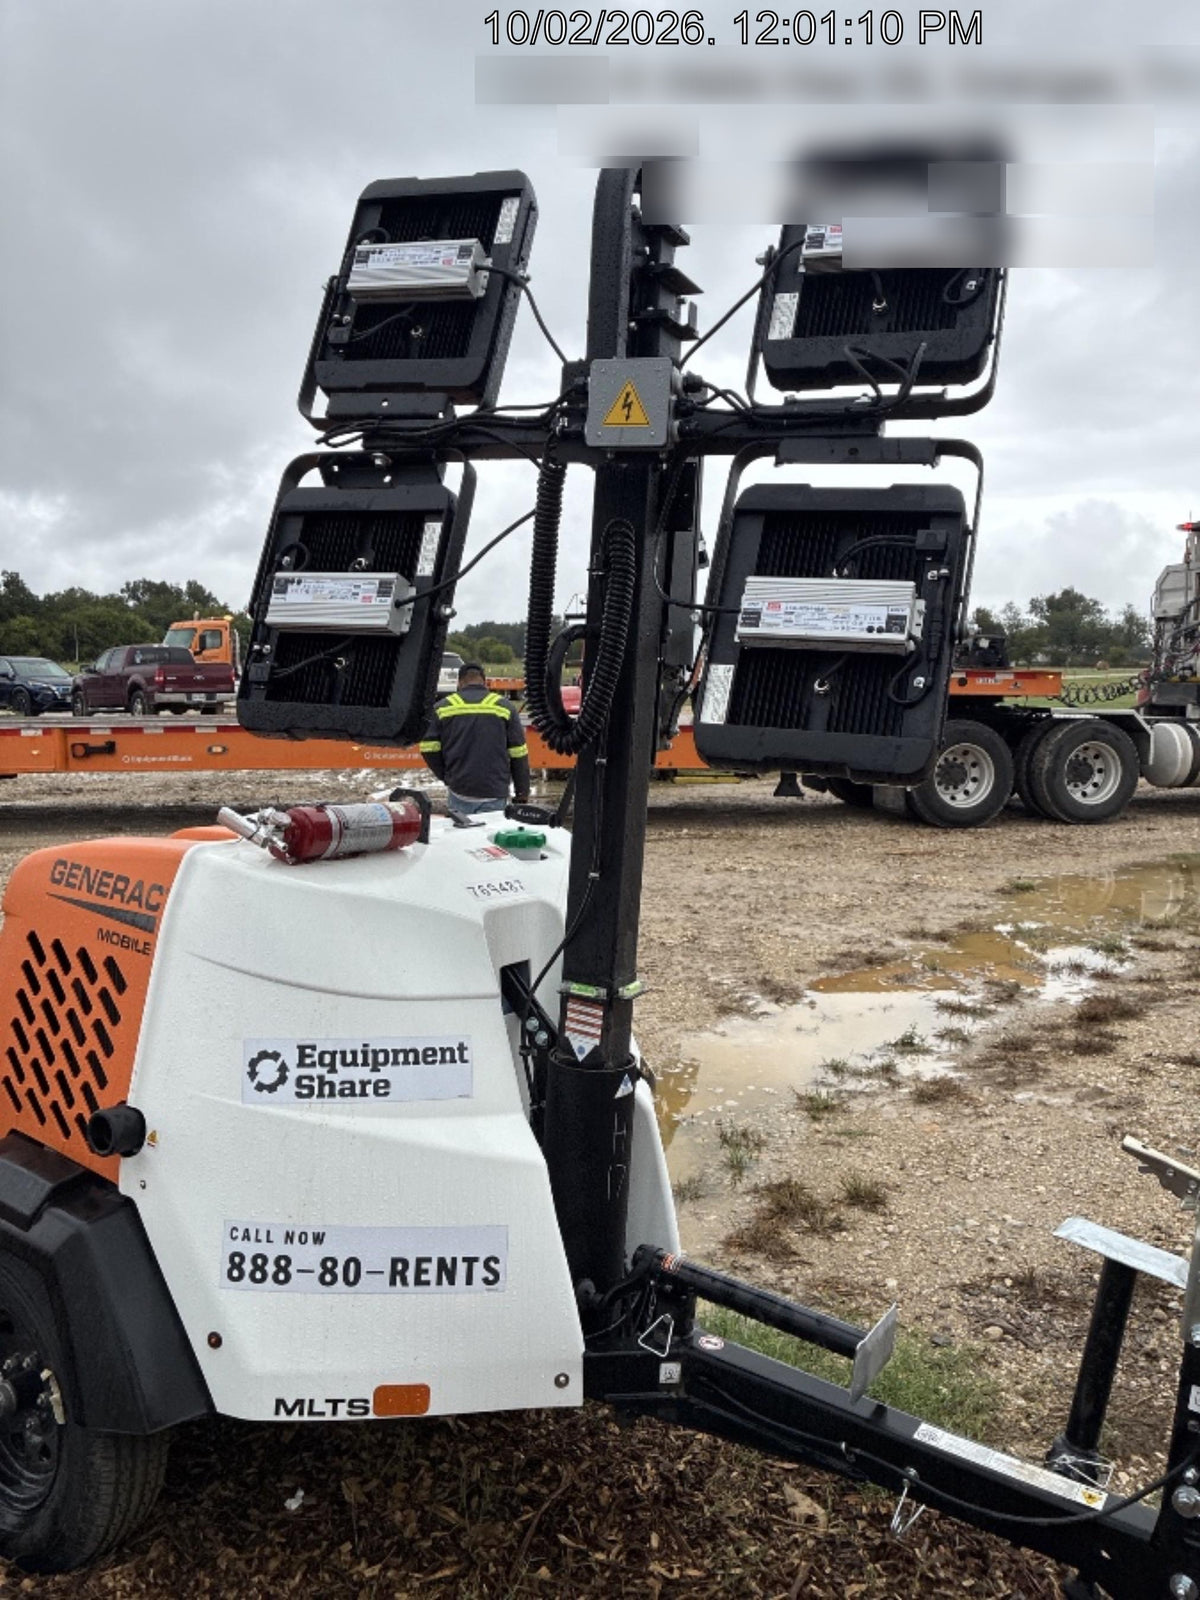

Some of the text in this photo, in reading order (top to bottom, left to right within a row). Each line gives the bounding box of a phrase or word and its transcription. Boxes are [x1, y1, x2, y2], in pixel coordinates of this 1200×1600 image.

[50, 859, 165, 912] GENERAC
[97, 928, 152, 956] MOBILE
[296, 1042, 468, 1073] Equipment
[295, 1075, 391, 1099] Share
[229, 1227, 326, 1246] CALL NOW
[226, 1251, 501, 1287] 888-80-RENTS
[274, 1398, 371, 1417] MLTS
